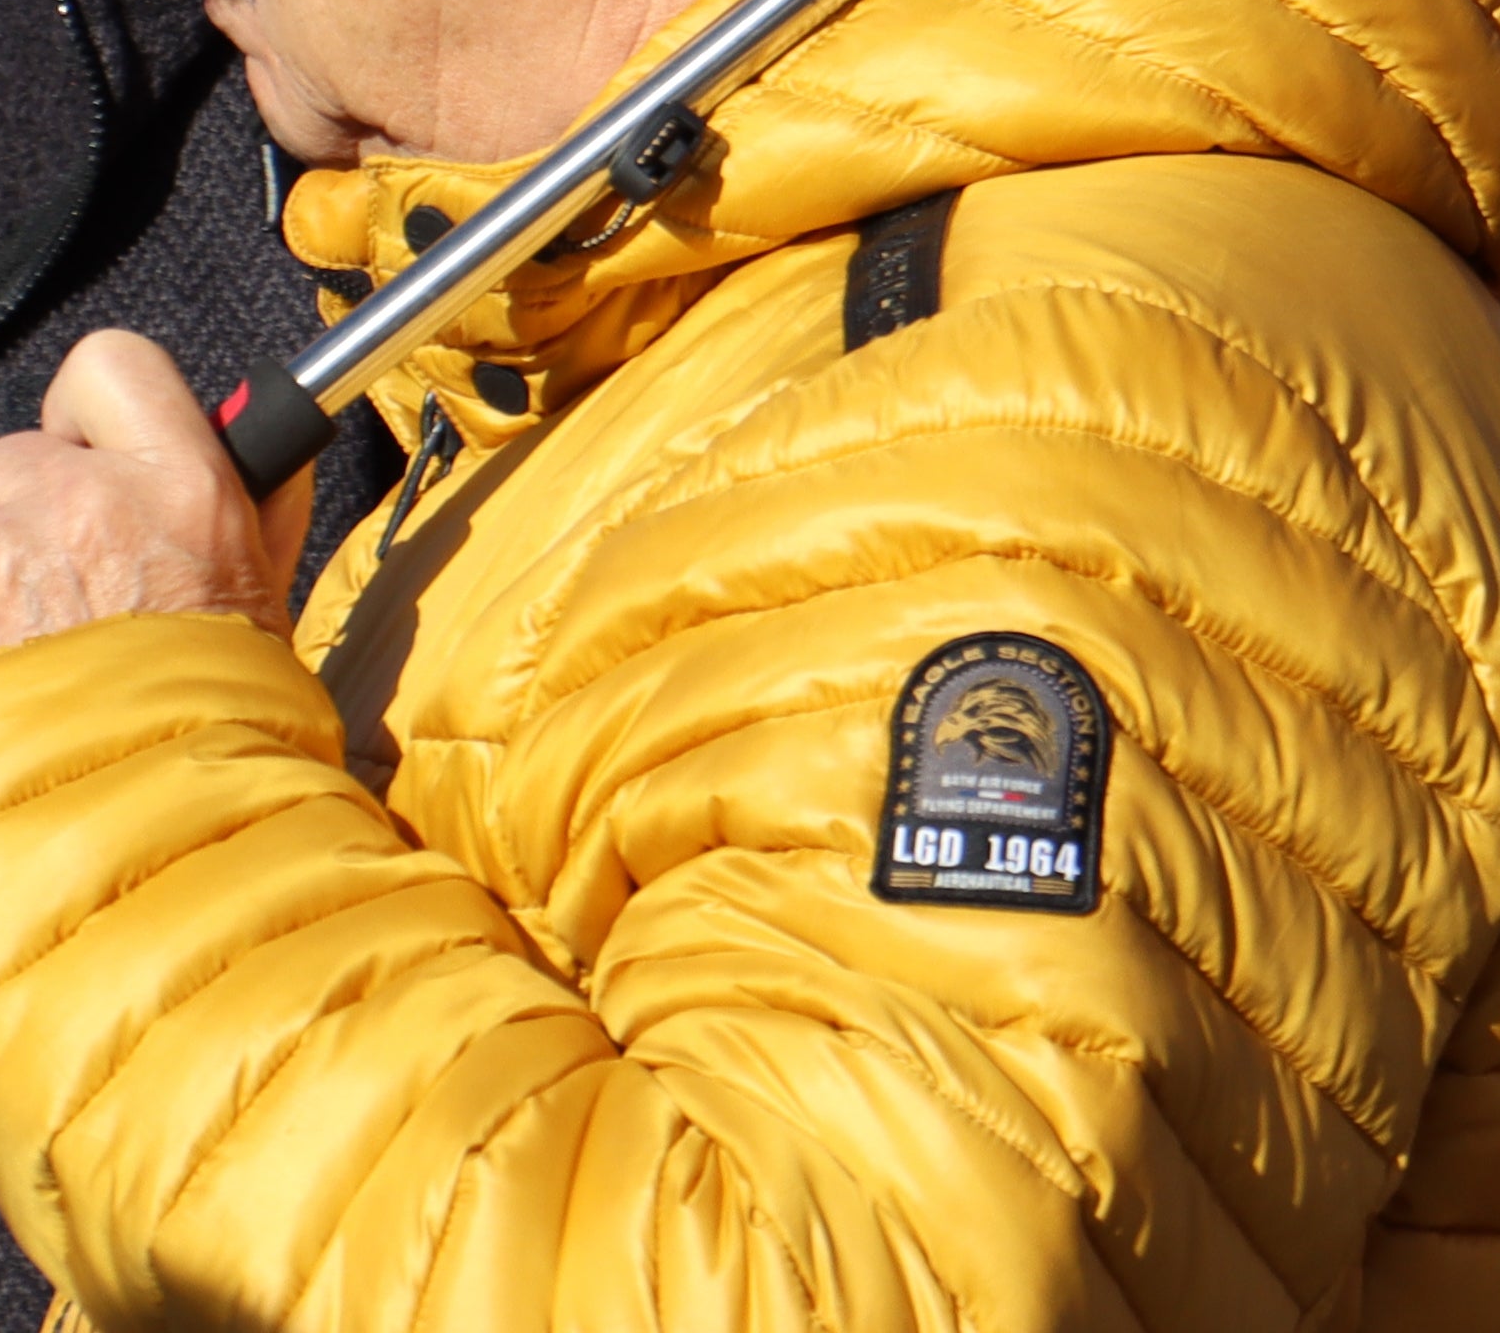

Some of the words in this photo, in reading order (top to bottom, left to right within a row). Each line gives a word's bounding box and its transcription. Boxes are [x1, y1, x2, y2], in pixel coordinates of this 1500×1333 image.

[998, 646, 1095, 735] SECTION
[893, 825, 965, 867] LGD
[984, 835, 1081, 881] 1964
